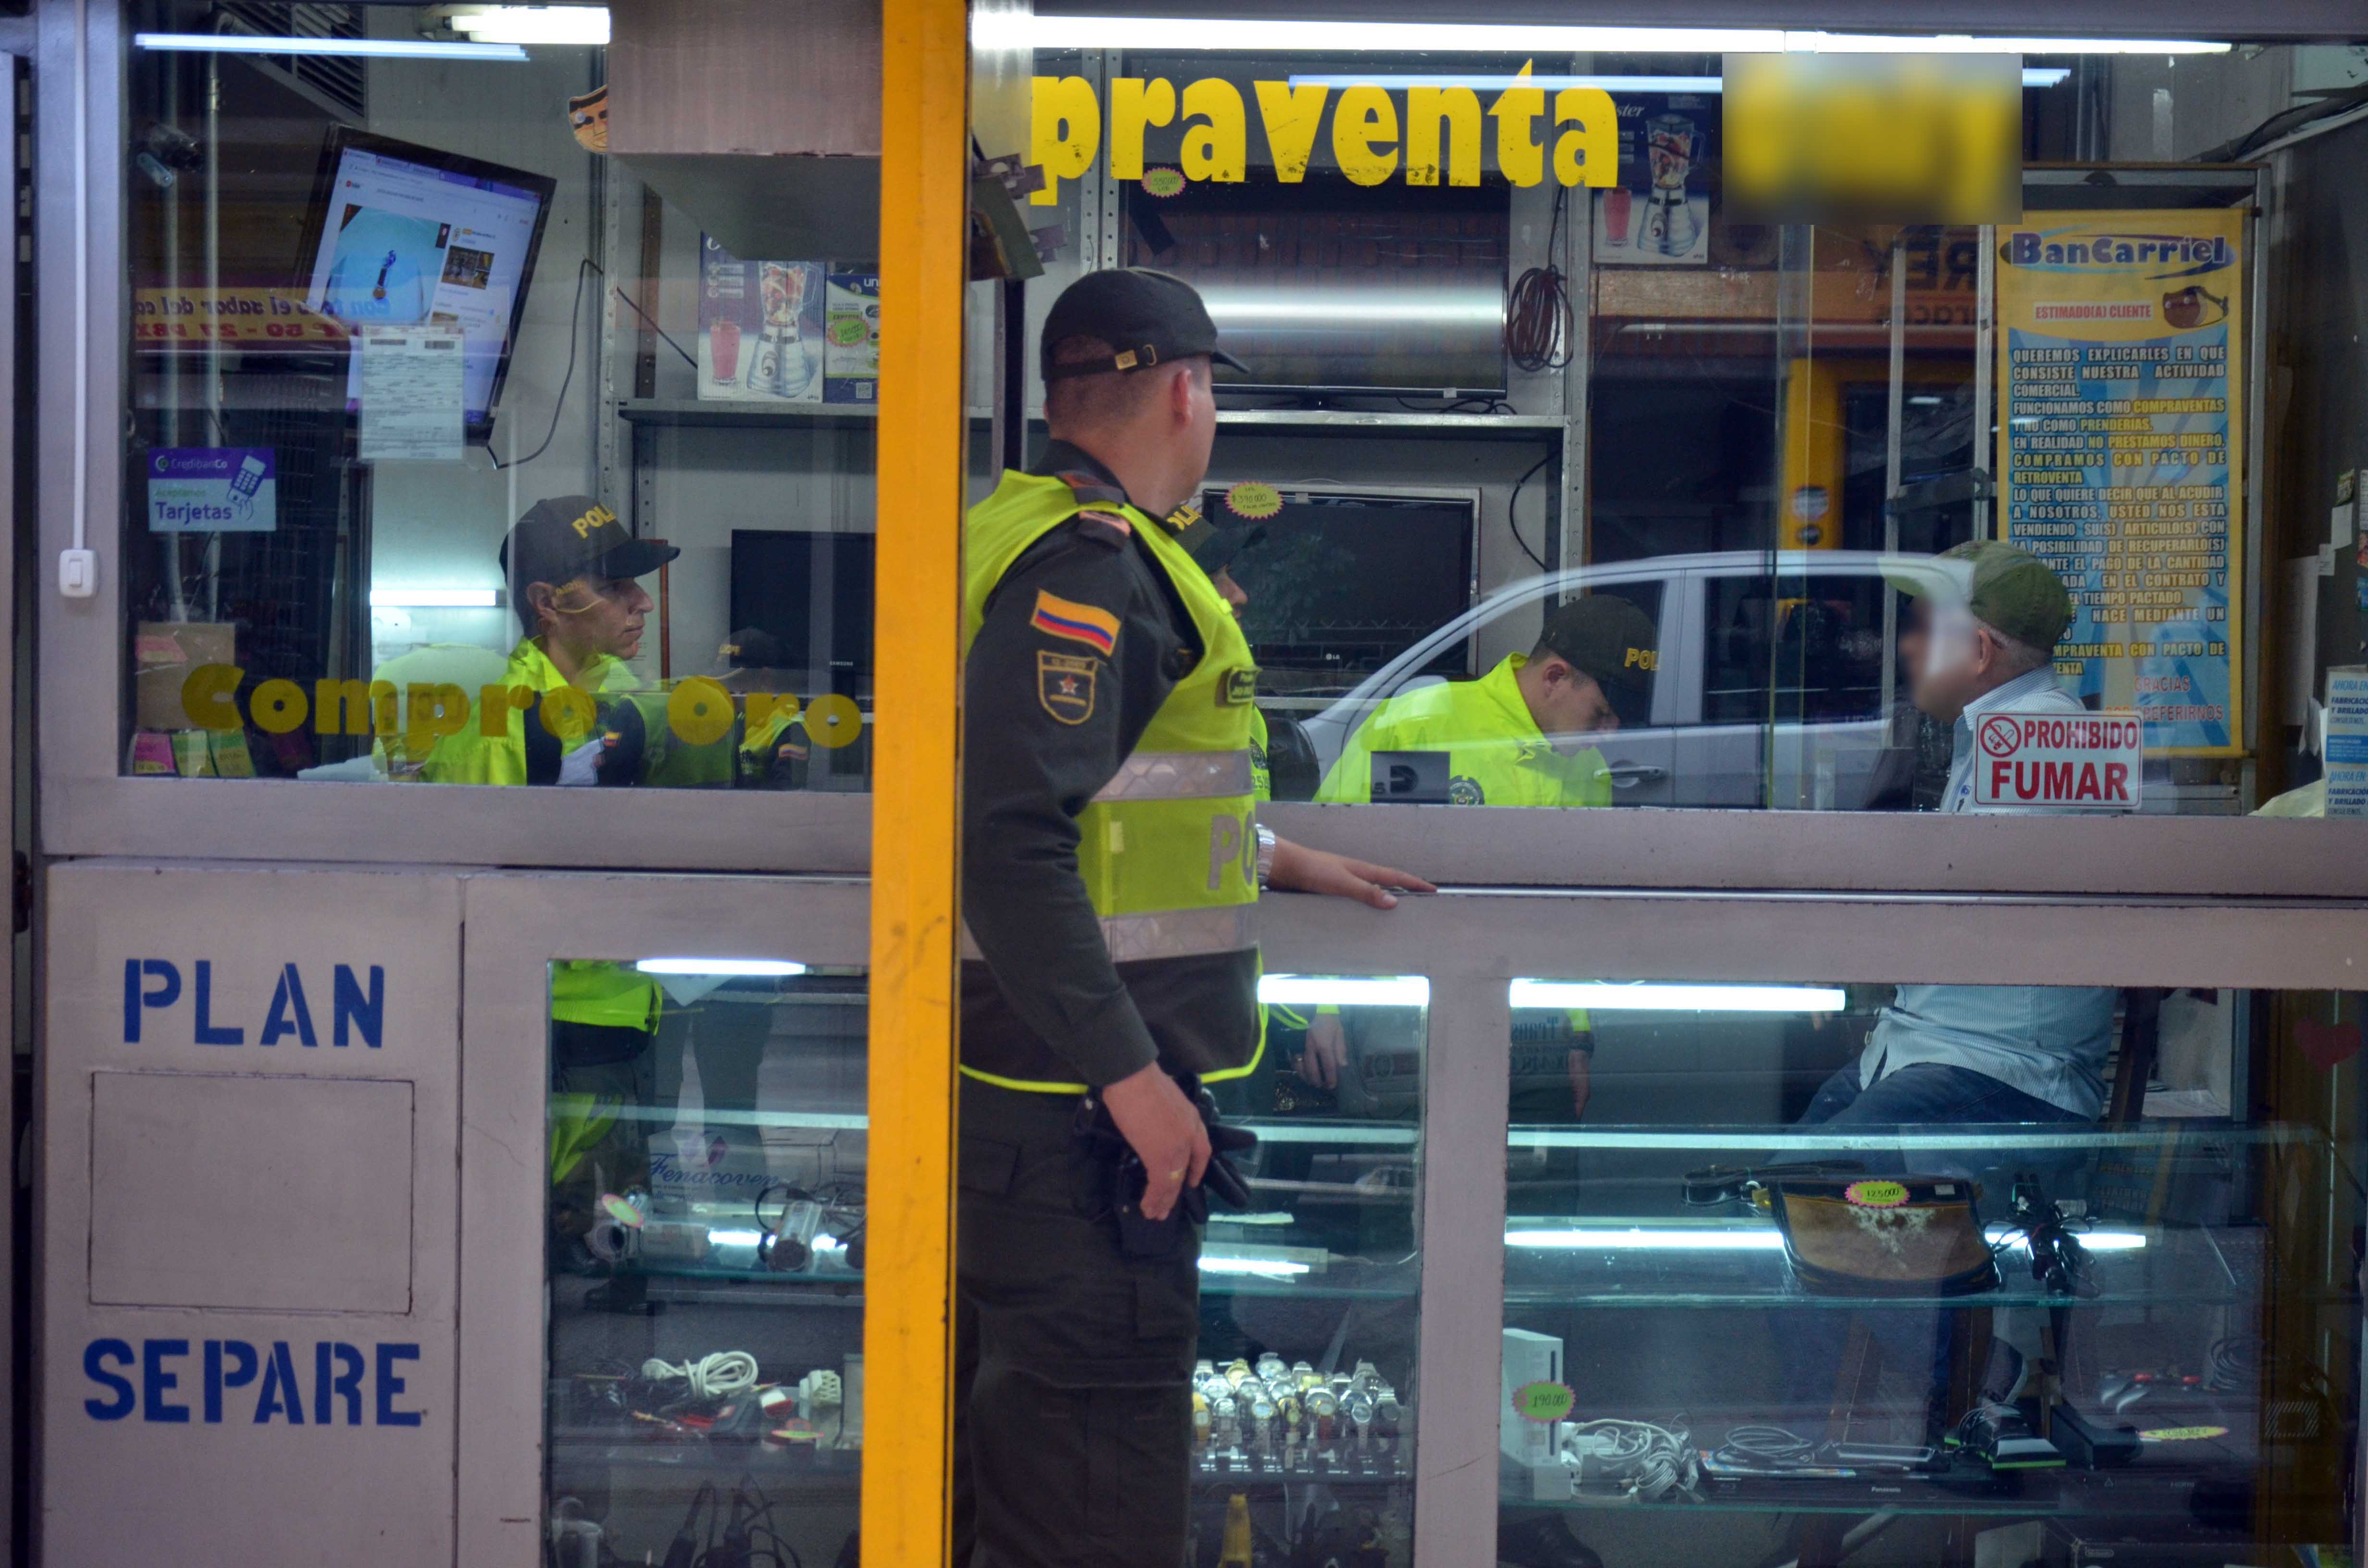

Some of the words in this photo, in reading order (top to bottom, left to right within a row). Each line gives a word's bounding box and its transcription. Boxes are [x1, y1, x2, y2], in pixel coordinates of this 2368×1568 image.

[1615, 103, 1645, 118] ster
[2011, 232, 2226, 265] BanCarriel
[2035, 305, 2107, 319] ESTIMADO(A)
[2109, 303, 2152, 318] CLIENTE
[2013, 349, 2080, 363] QUEREMOS
[2088, 347, 2169, 361] EXPLICARLES
[2177, 347, 2192, 360] EN
[2200, 346, 2224, 360] QUE
[2013, 367, 2075, 380] CONSISTE
[2082, 366, 2139, 380] NUESTRA
[2155, 364, 2225, 379] ACTIVIDAD
[2013, 383, 2081, 397] COMERCIAL.
[2013, 401, 2094, 415] FUNCIONAMOS
[2097, 401, 2132, 414] COMO
[2133, 399, 2225, 414] COMPRAVENTAS
[2043, 418, 2076, 432] COMO
[2080, 417, 2153, 431] PRENDERIAS.
[2014, 436, 2027, 449] EN
[2031, 436, 2084, 449] REALIDAD
[2088, 435, 2104, 449] NO
[2108, 434, 2176, 449] PRESTAMOS
[2013, 453, 2104, 467] COMPRAMOS
[2113, 453, 2143, 466] CON
[2151, 451, 2199, 465] PACTO
[2207, 450, 2226, 464] DE
[2013, 470, 2083, 484] RETROVENTA
[2013, 489, 2027, 501] LO
[2031, 488, 2052, 502] QUE
[2055, 488, 2095, 502] QUIERE
[2098, 487, 2133, 501] DECIR
[2136, 487, 2158, 502] QUE
[2162, 487, 2176, 500] AL
[2179, 486, 2224, 500] ACUDIR
[155, 502, 233, 525] Tarjetas
[2013, 506, 2022, 518] A
[2109, 504, 2151, 518] USTED
[2158, 504, 2185, 517] NOS
[2193, 503, 2226, 516] ESTA
[2012, 523, 2076, 536] VENDIENDO
[2084, 522, 2117, 536] SU(S)
[2124, 521, 2197, 535] ARTICULO(S)
[2200, 520, 2225, 534] CON
[2032, 540, 2103, 553] POSIBILIDAD
[2109, 539, 2123, 552] DE
[2128, 538, 2225, 552] RECUPERARLO(S)
[2074, 557, 2086, 570] EL
[2091, 557, 2122, 570] PAGO
[2127, 556, 2143, 570] DE
[2147, 555, 2161, 569] LA
[2167, 555, 2225, 569] CANTIDAD
[2102, 574, 2118, 588] EN
[2124, 573, 2138, 587] EL
[2145, 573, 2209, 587] CONTRATO
[2217, 572, 2225, 586] Y
[2083, 591, 2126, 605] TIEMPO
[2129, 590, 2182, 604] PACTADO
[2092, 608, 2127, 623] HACE
[2134, 606, 2199, 622] MEDIANTE
[2206, 607, 2225, 621] UN
[2053, 644, 2124, 658] MPRAVENTA
[2130, 643, 2156, 657] CON
[2163, 642, 2202, 656] PACTO
[2208, 642, 2225, 656] DE
[2134, 676, 2191, 692] GRACIAS
[181, 663, 597, 753] Compro
[667, 675, 862, 749] Oro
[2024, 721, 2137, 749] PROHIBIDO
[1991, 760, 2130, 801] FUMAR
[123, 958, 384, 1049] PLAN
[83, 1337, 421, 1427] SEPARE
